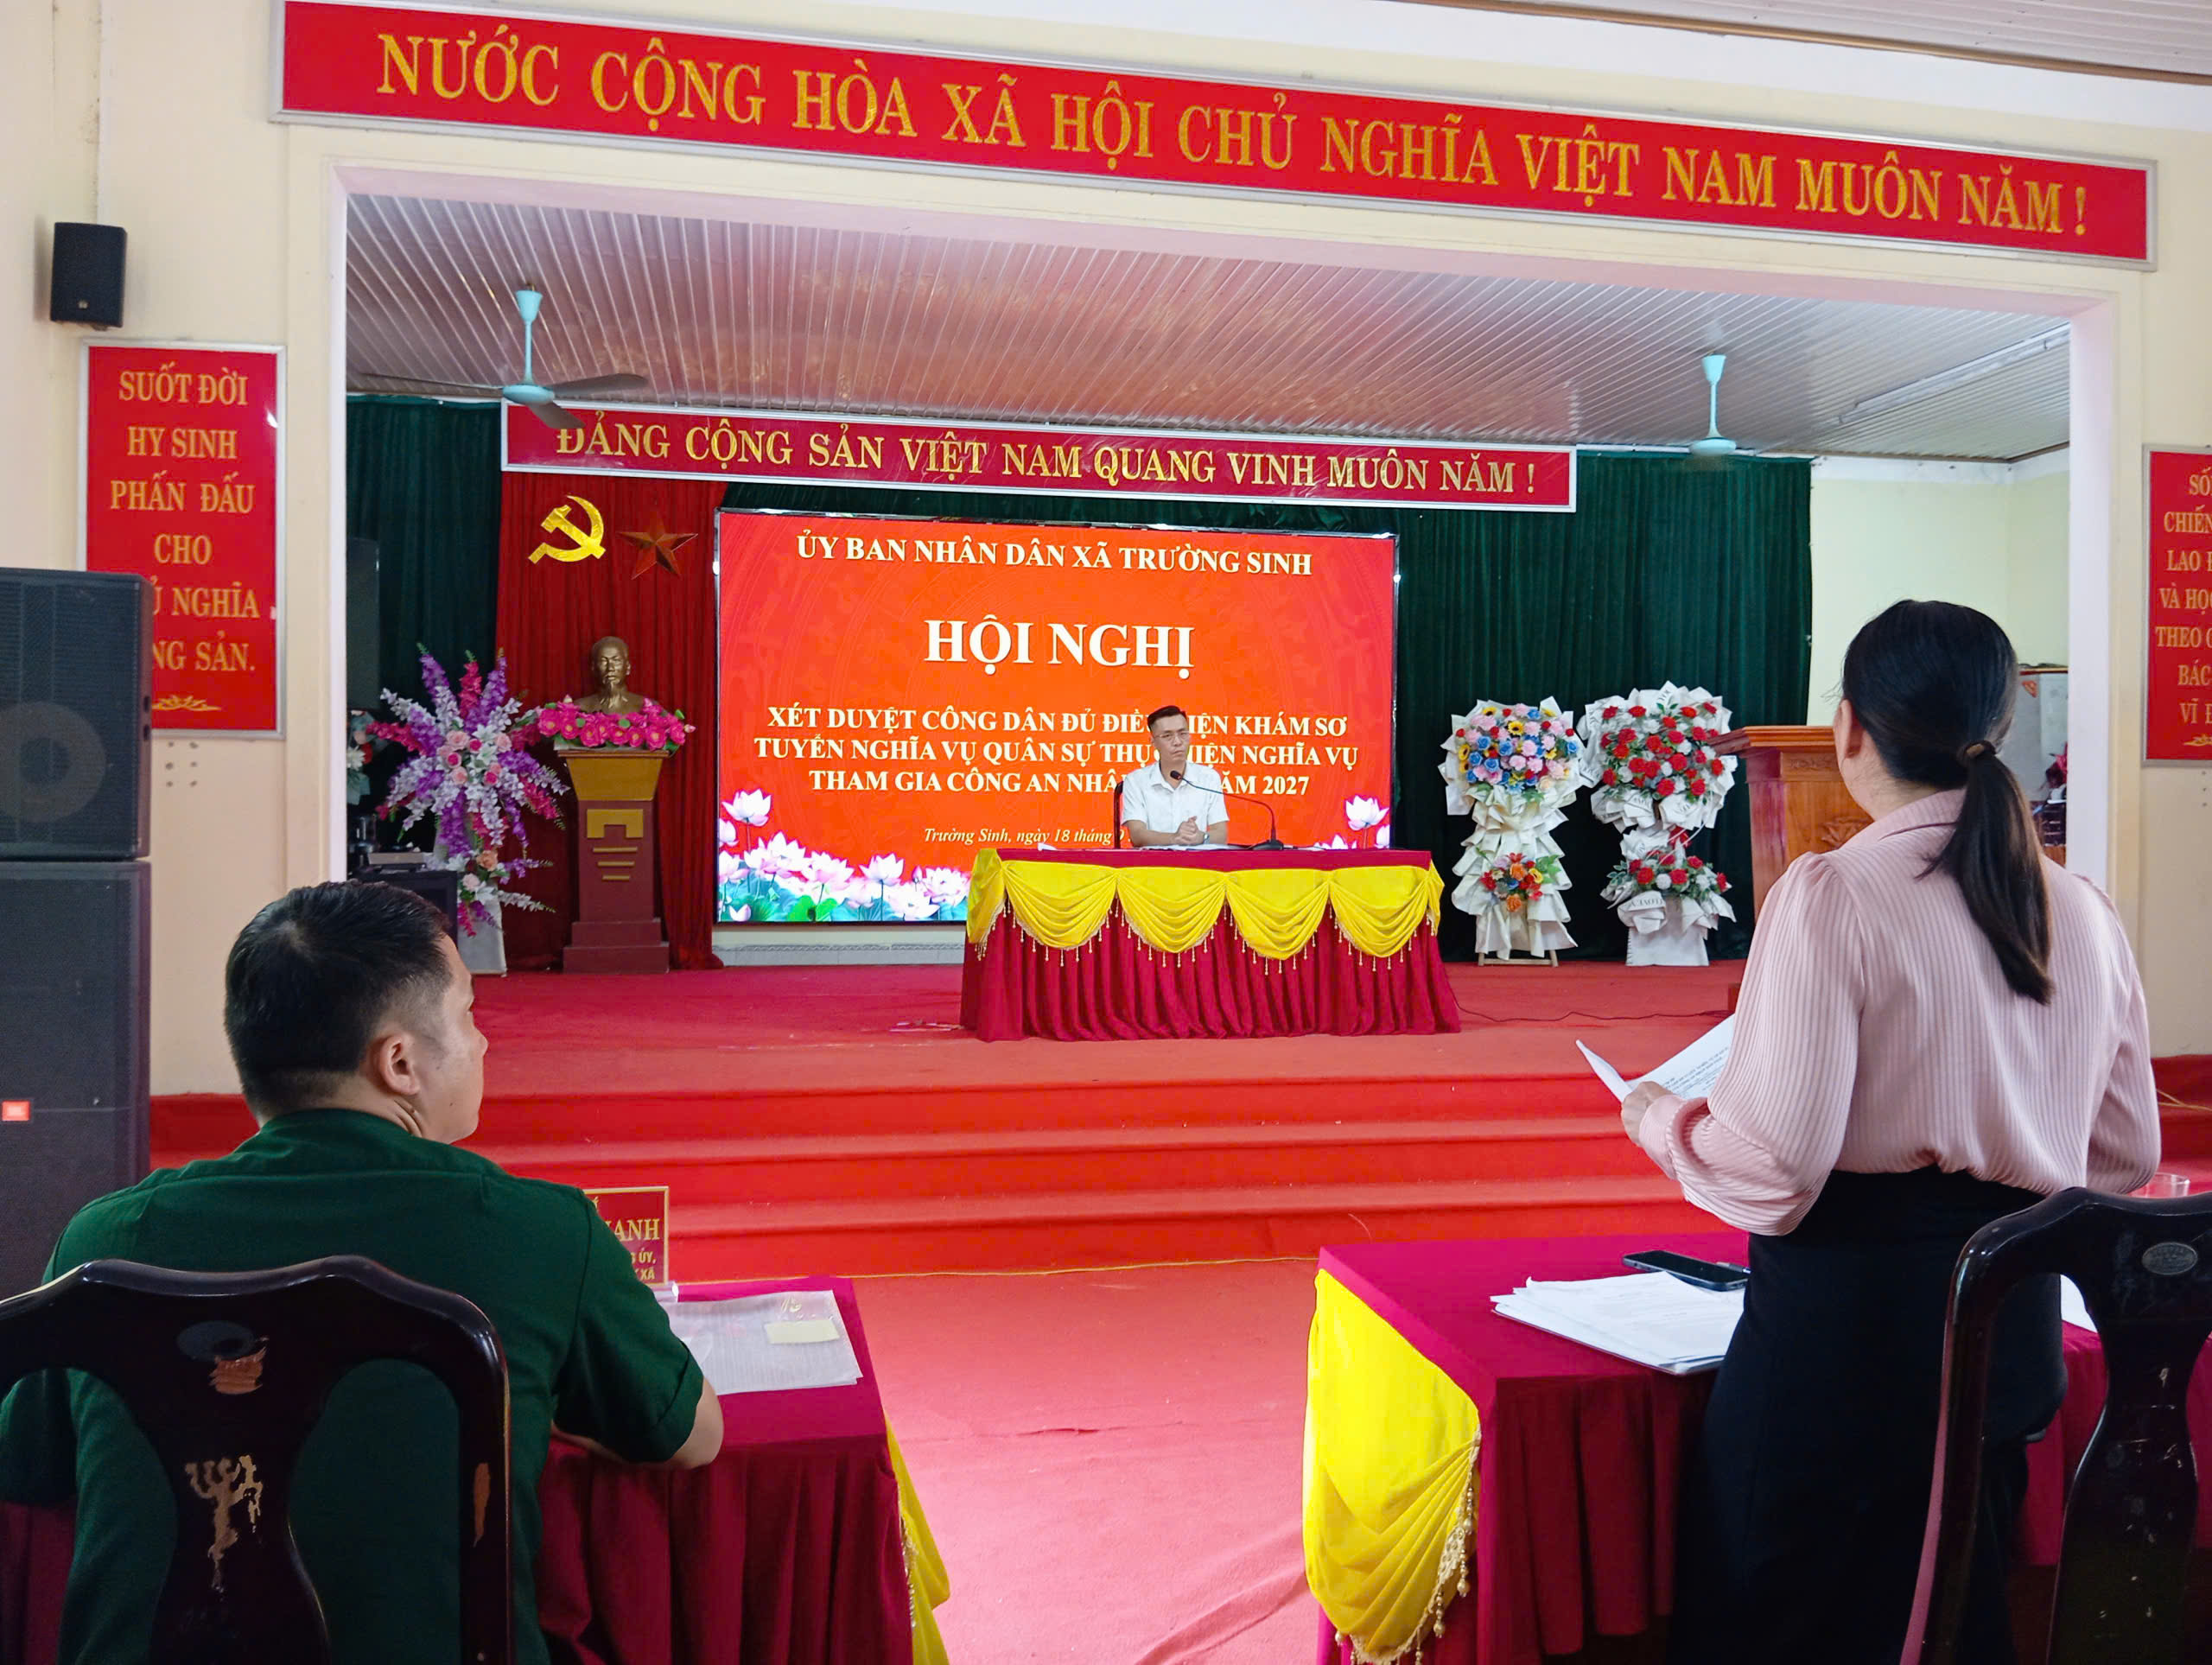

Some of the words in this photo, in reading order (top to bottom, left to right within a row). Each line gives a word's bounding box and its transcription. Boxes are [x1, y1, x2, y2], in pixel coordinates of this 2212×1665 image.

[378, 24, 558, 105] NƯỚC
[591, 37, 766, 131] CỘNG
[792, 59, 918, 137] HÒA
[942, 73, 1026, 147] XÃ
[1051, 80, 1154, 169] HỘI
[1179, 92, 1297, 169] CHỦ
[1320, 113, 1498, 185] NGHĨA
[1516, 124, 1639, 207] VIỆT
[1662, 147, 1777, 207] NAM
[1796, 150, 1942, 220] MUÔN
[119, 361, 192, 403] SUỐT
[199, 367, 247, 405] ĐỜI
[128, 426, 165, 456] HY
[172, 428, 237, 459] SINH
[556, 410, 670, 457] ĐẢNG
[686, 418, 792, 469] CỘNG
[810, 423, 884, 468] SẢN
[899, 431, 987, 480] VIỆT
[1002, 444, 1082, 478] NAM
[1094, 446, 1216, 486] QUANG
[1227, 453, 1314, 486] VINH
[1327, 448, 1428, 489] MUÔN
[111, 470, 186, 511] PHẤN
[200, 472, 254, 513] ĐẤU
[2189, 467, 2212, 496] SỐ
[155, 534, 212, 564] CHO
[798, 530, 838, 558] ỦY
[846, 537, 906, 561] BAN
[915, 536, 997, 563] NHÂN
[1007, 538, 1065, 566] DÂN
[1073, 542, 1111, 568] XÃ
[1119, 543, 1239, 572] TRƯỜNG
[1248, 552, 1311, 575] SINH
[2167, 550, 2202, 571] LAO
[172, 581, 260, 618] NGHĨA
[2159, 582, 2181, 608] VÀ
[2185, 588, 2212, 614] HỌ
[153, 639, 187, 671] NG
[195, 630, 255, 671] SẢN.
[925, 614, 1033, 674] HỘI
[1049, 624, 1193, 678] NGHỊ
[2155, 626, 2202, 647] THEO
[768, 702, 821, 727] XÉT
[828, 707, 916, 734] DUYỆT
[923, 705, 996, 730] CÔNG
[1004, 707, 1055, 731] DÂN
[1062, 709, 1096, 732] ĐỦ
[1103, 709, 1150, 733] ĐIỀ
[1188, 713, 1228, 739] IỆN
[1236, 712, 1309, 735] KHÁM
[1315, 717, 1347, 736] SƠ
[2180, 698, 2199, 723] VĨ
[852, 736, 936, 759] NGHĨA
[942, 741, 976, 766] VỤ
[983, 737, 1054, 765] QUÂN
[1062, 740, 1096, 766] SỰ
[1243, 742, 1320, 765] NGHĨA
[1325, 747, 1357, 770] VỤ
[809, 771, 887, 790] THAM
[895, 772, 942, 791] GIA
[947, 767, 1020, 791] CÔNG
[1026, 773, 1059, 791] AN
[1068, 769, 1126, 792] NHÂ
[1221, 771, 1256, 795] ĂM
[1262, 776, 1309, 795] 2027
[925, 829, 975, 845] Trường
[978, 829, 1011, 842] Sinh,
[1017, 832, 1051, 845] ngày
[1055, 829, 1070, 842] 18
[1074, 829, 1112, 845] tháng
[605, 1218, 660, 1242] ANH
